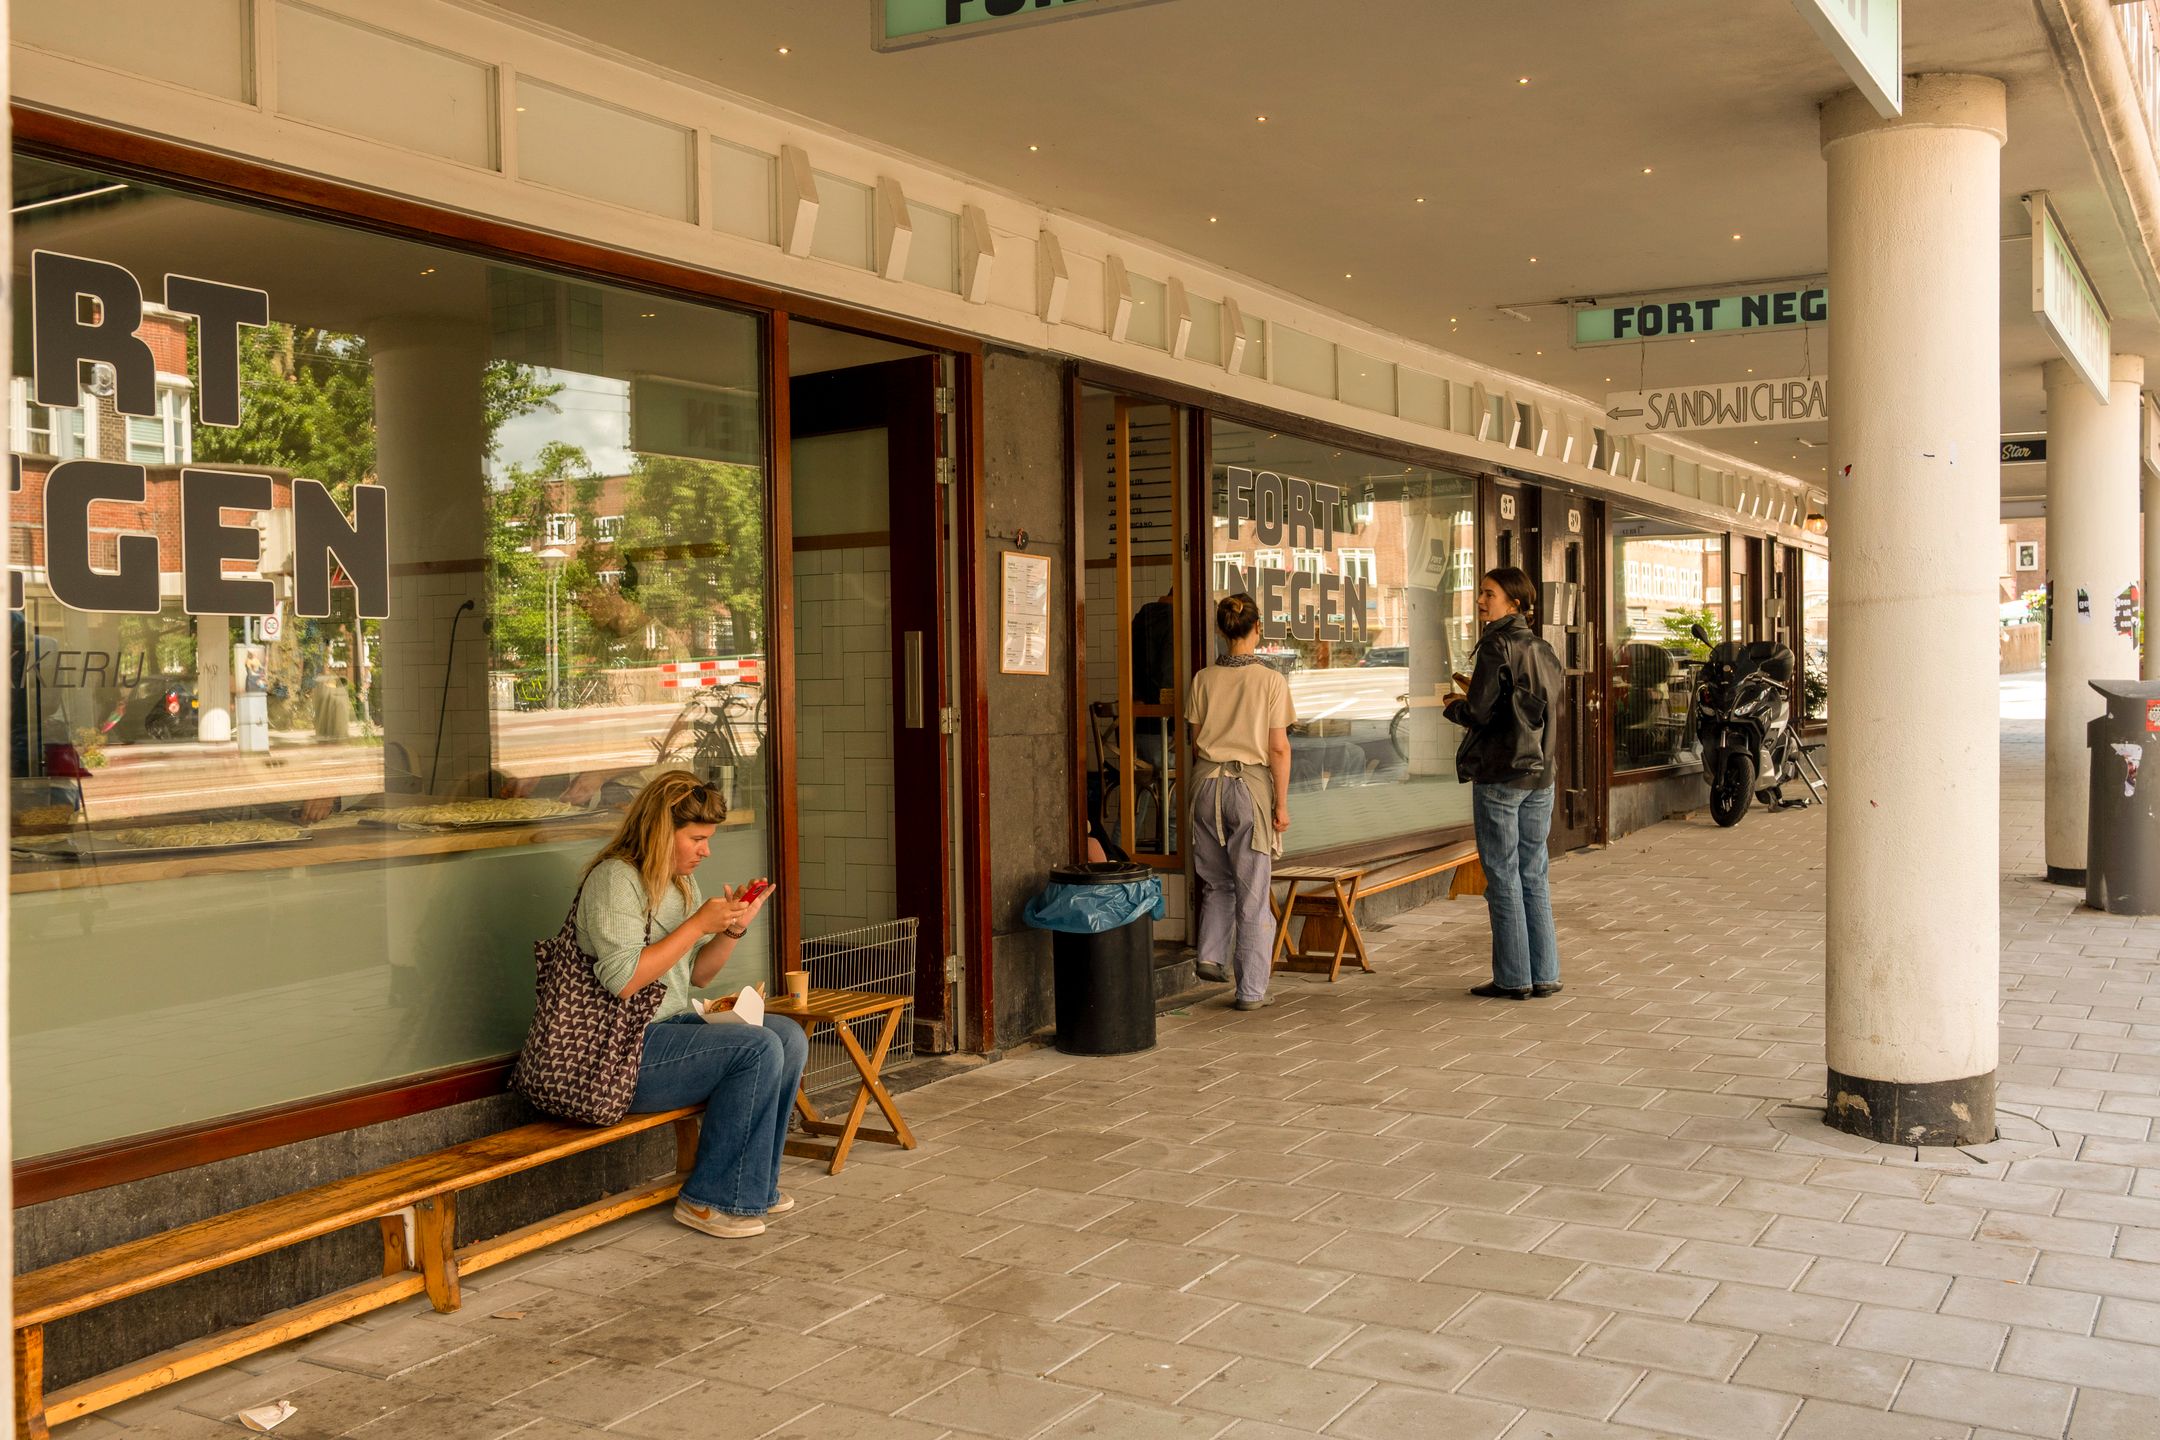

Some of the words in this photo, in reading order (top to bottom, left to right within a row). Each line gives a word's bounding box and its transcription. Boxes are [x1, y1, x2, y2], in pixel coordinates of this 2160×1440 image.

[32, 249, 269, 428] RT
[1613, 299, 1720, 338] FORT
[1742, 289, 1827, 327] NEG
[1645, 380, 1828, 431] SANDWICHBA
[1228, 466, 1339, 552] FORT
[1503, 498, 1513, 514] 37
[1570, 512, 1579, 528] 39
[9, 452, 390, 619] GEN
